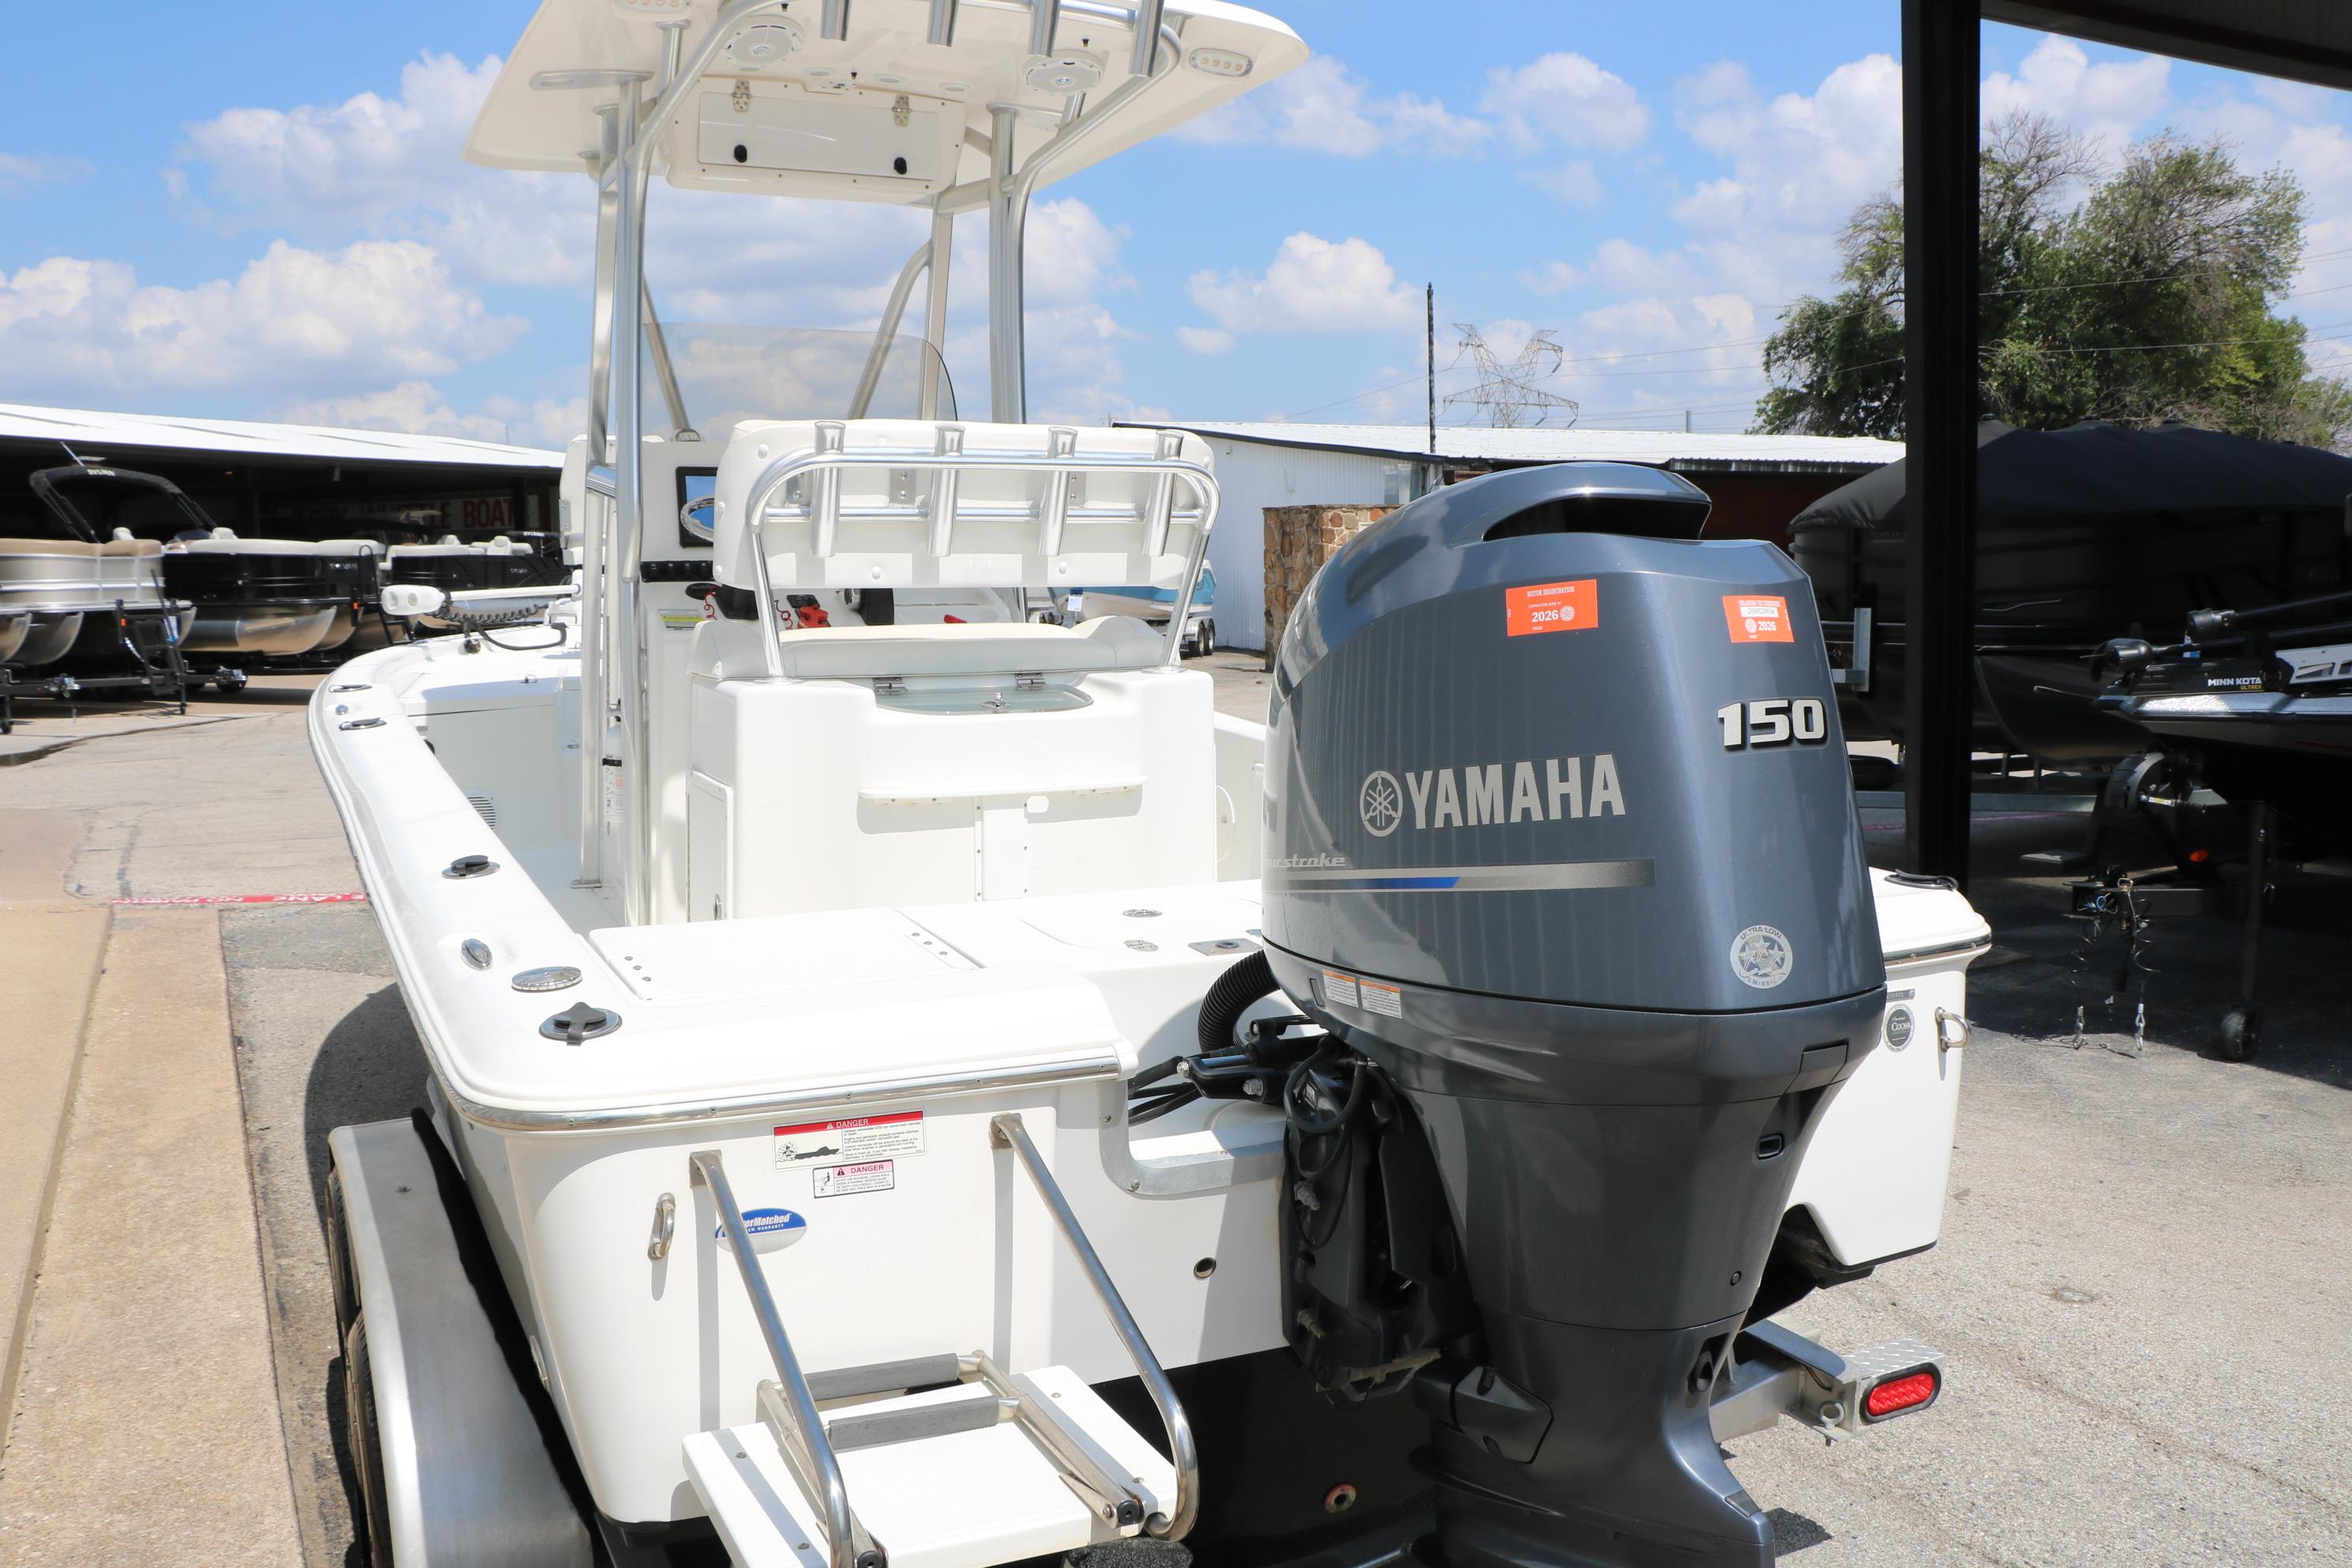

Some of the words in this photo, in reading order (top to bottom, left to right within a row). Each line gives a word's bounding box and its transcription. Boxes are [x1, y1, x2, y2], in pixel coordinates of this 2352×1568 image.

[1532, 609, 1559, 623] 2026
[1757, 620, 1777, 631] 2026
[2207, 678, 2234, 687] MINN
[2236, 677, 2263, 685] KOTA
[1717, 699, 1826, 748] 150
[1404, 753, 1626, 830] YAMAHA
[836, 1118, 869, 1129] DANGER
[850, 1164, 884, 1174] DANGER
